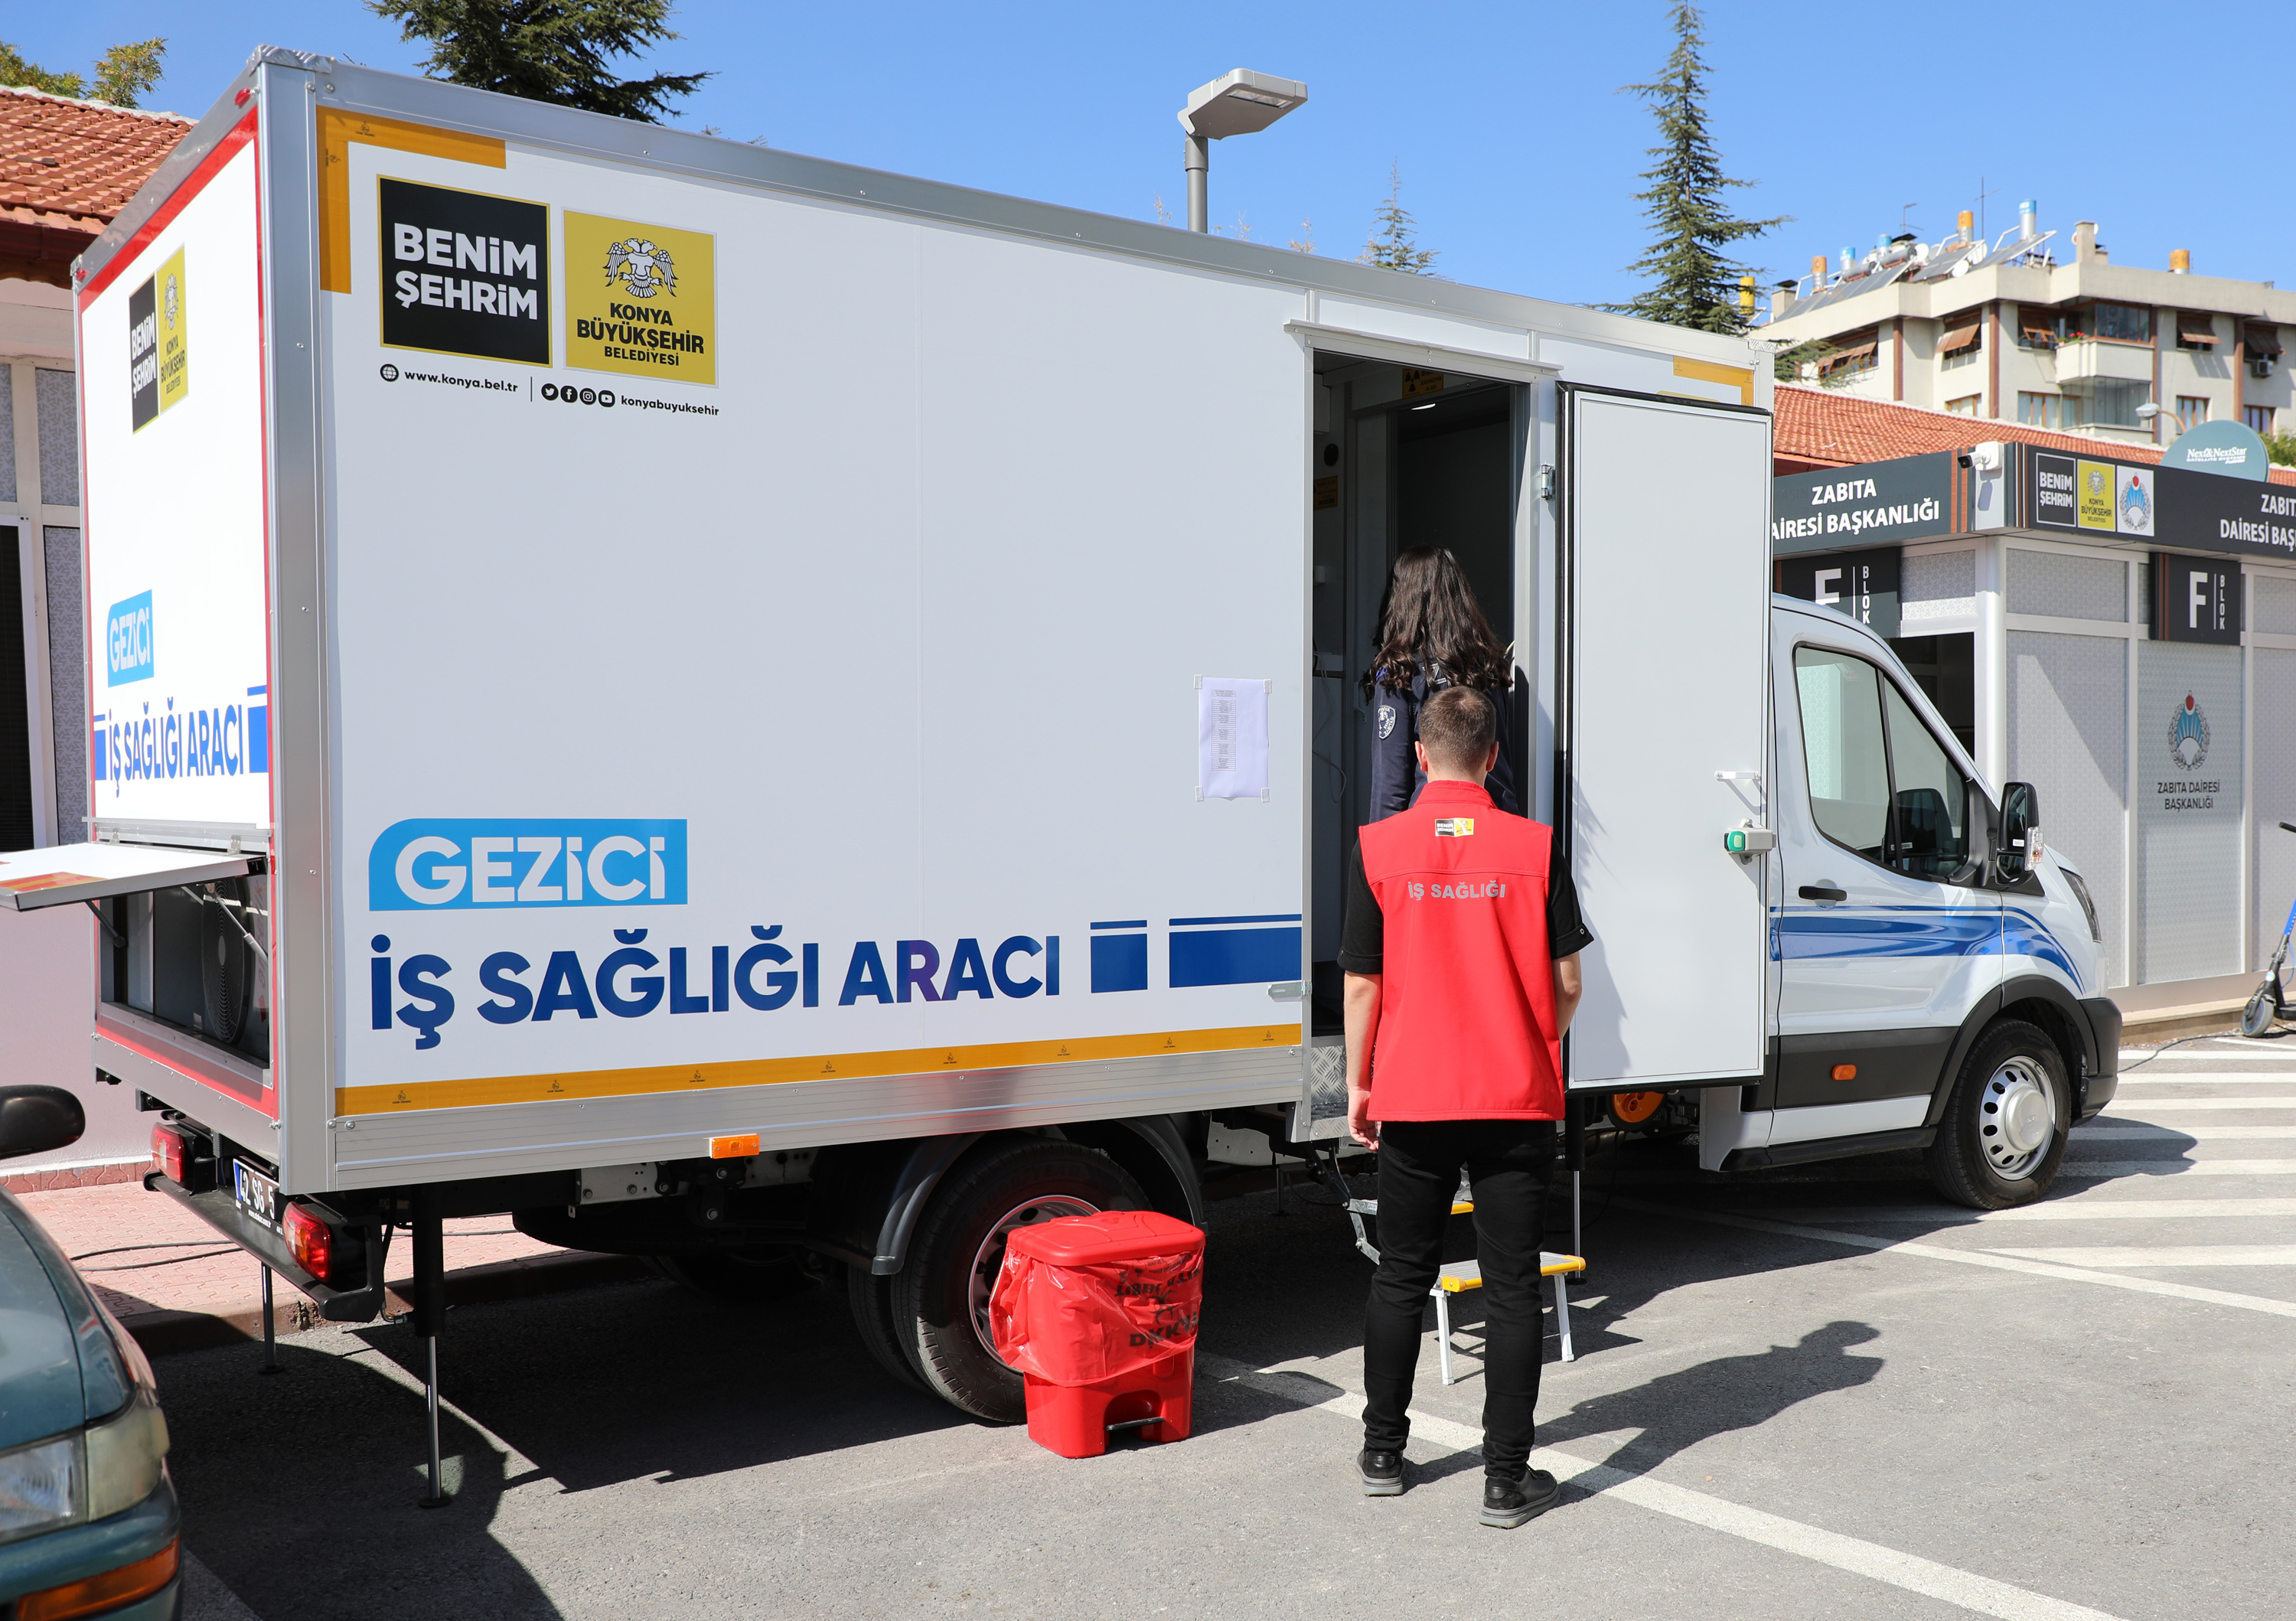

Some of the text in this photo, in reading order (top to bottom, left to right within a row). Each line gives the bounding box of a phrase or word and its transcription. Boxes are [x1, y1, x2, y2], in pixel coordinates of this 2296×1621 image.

[394, 223, 537, 280] BENİM
[395, 270, 538, 321] ŞEHRİM
[610, 303, 673, 327] KONYA
[132, 311, 155, 361] BENİM
[166, 334, 179, 356] KONYA
[577, 318, 704, 354] BÜYÜKŞEHİR
[604, 345, 680, 367] BELEDİYESİ
[132, 351, 157, 399] ŞEHRİM
[404, 370, 719, 416] www.konya.bel.tr konyabuyuksehir
[1811, 478, 1877, 506] ZABITA
[2040, 471, 2073, 491] BENİM
[2040, 491, 2073, 508] ŞEHRİM
[2081, 504, 2112, 517] BÜYÜKŞEHİR
[2089, 497, 2105, 506] KONYA
[2260, 494, 2296, 517] ZABIT
[1773, 512, 1823, 540] AİRESİ
[1827, 497, 1939, 535] BAŞKANLIĞI
[2220, 517, 2269, 544] DAİRESİ
[2271, 526, 2296, 553] BAŞ
[1862, 565, 1870, 625] BLOK
[2190, 571, 2208, 628] F
[109, 606, 151, 673] GEZİCİ
[109, 696, 244, 798] İŞ SAĞLIĞI ARACI
[2157, 779, 2220, 794] ZABITA DAİRESİ
[2164, 795, 2213, 813] BAŞKANLIĞI
[395, 835, 665, 905] GEZİCİ
[1407, 879, 1506, 901] İŞ SAĞLIĞI
[371, 925, 1060, 1050] İŞ SAĞLIĞI ARACI
[240, 1169, 251, 1205] 42
[253, 1176, 265, 1214] SG
